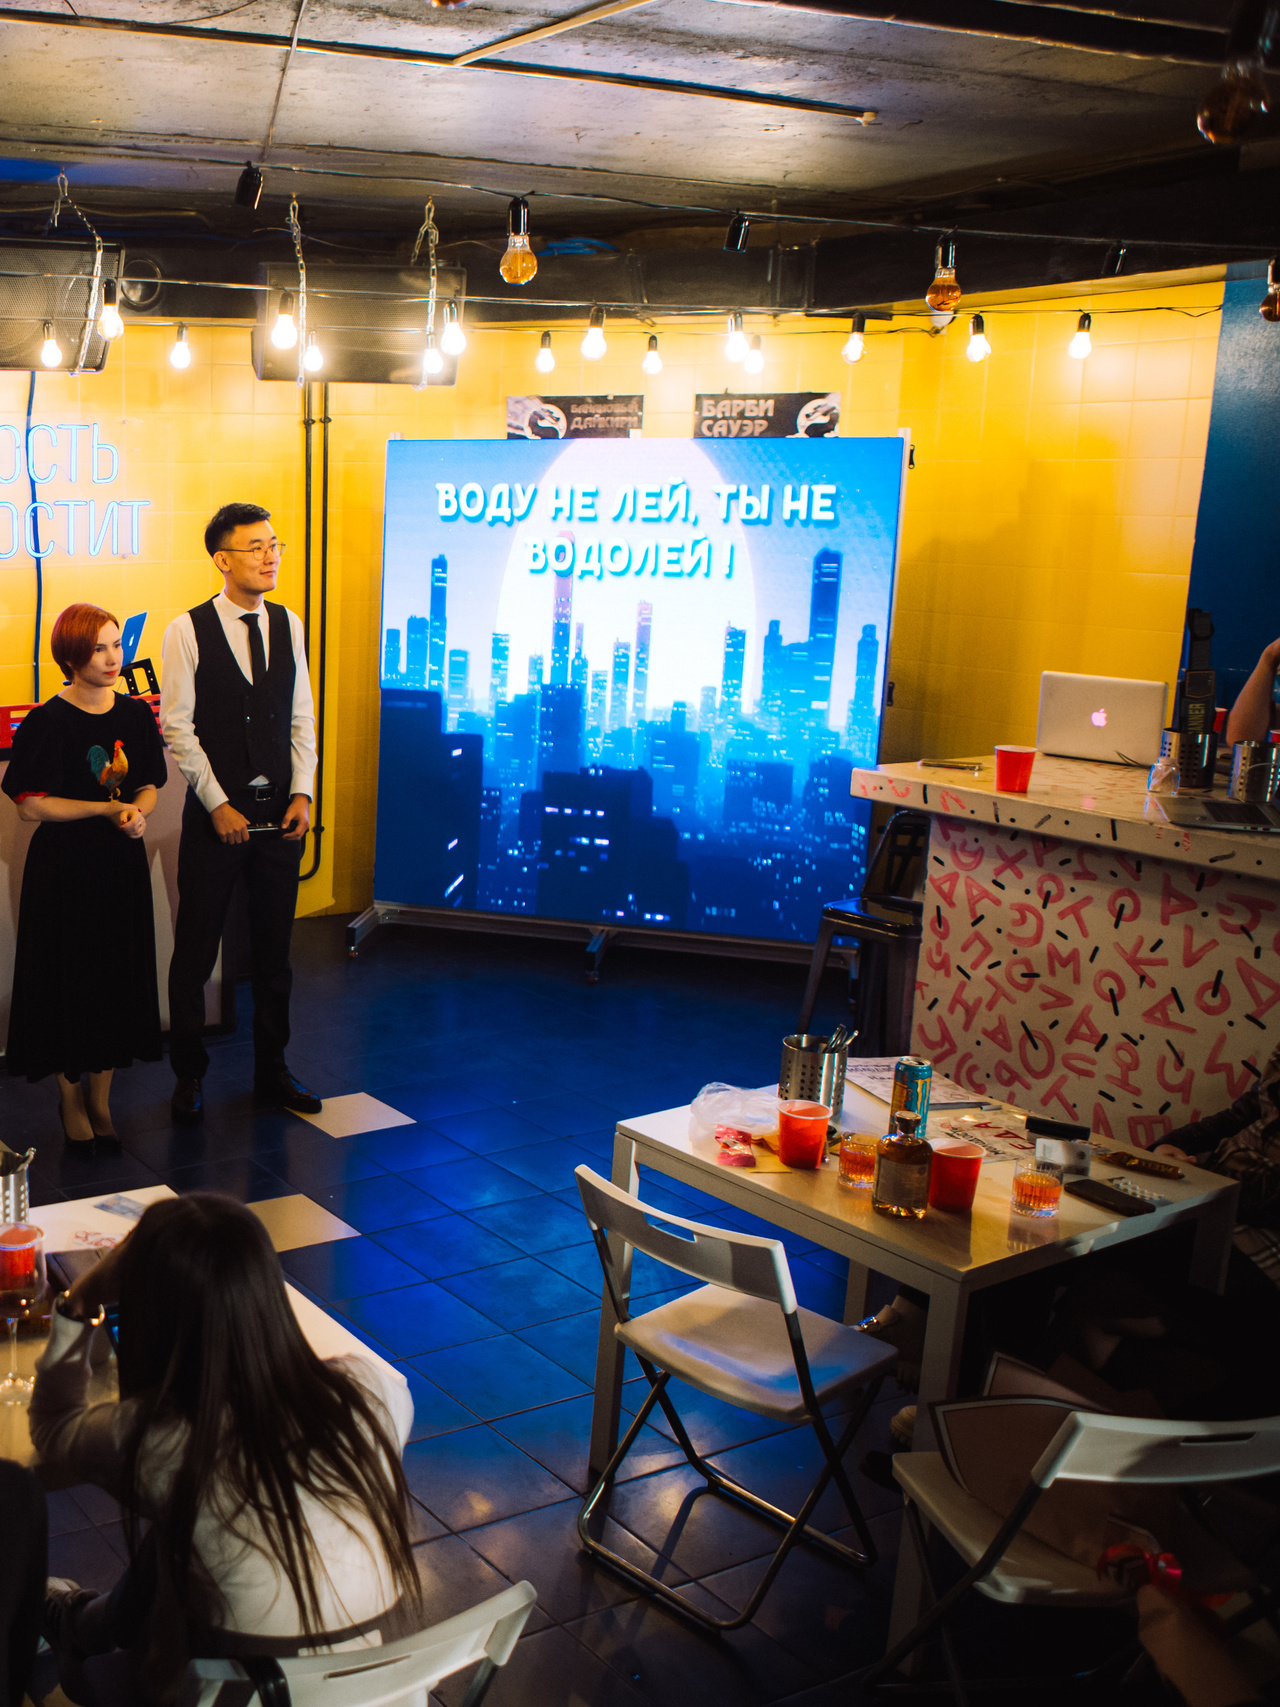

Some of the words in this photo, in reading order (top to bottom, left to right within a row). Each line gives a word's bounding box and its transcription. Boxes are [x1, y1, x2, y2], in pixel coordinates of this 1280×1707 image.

[702, 399, 775, 418] БАРБИ
[570, 414, 639, 430] ДАЙКИРИ
[701, 419, 769, 437] САУЭР
[436, 481, 537, 525] ВОДУ
[548, 483, 598, 520] НЕ
[611, 476, 698, 523] ЛЕЙ,
[715, 483, 770, 521] ТЫ
[782, 483, 838, 520] НЕ
[526, 530, 712, 577] ВОДОЛЕЙ
